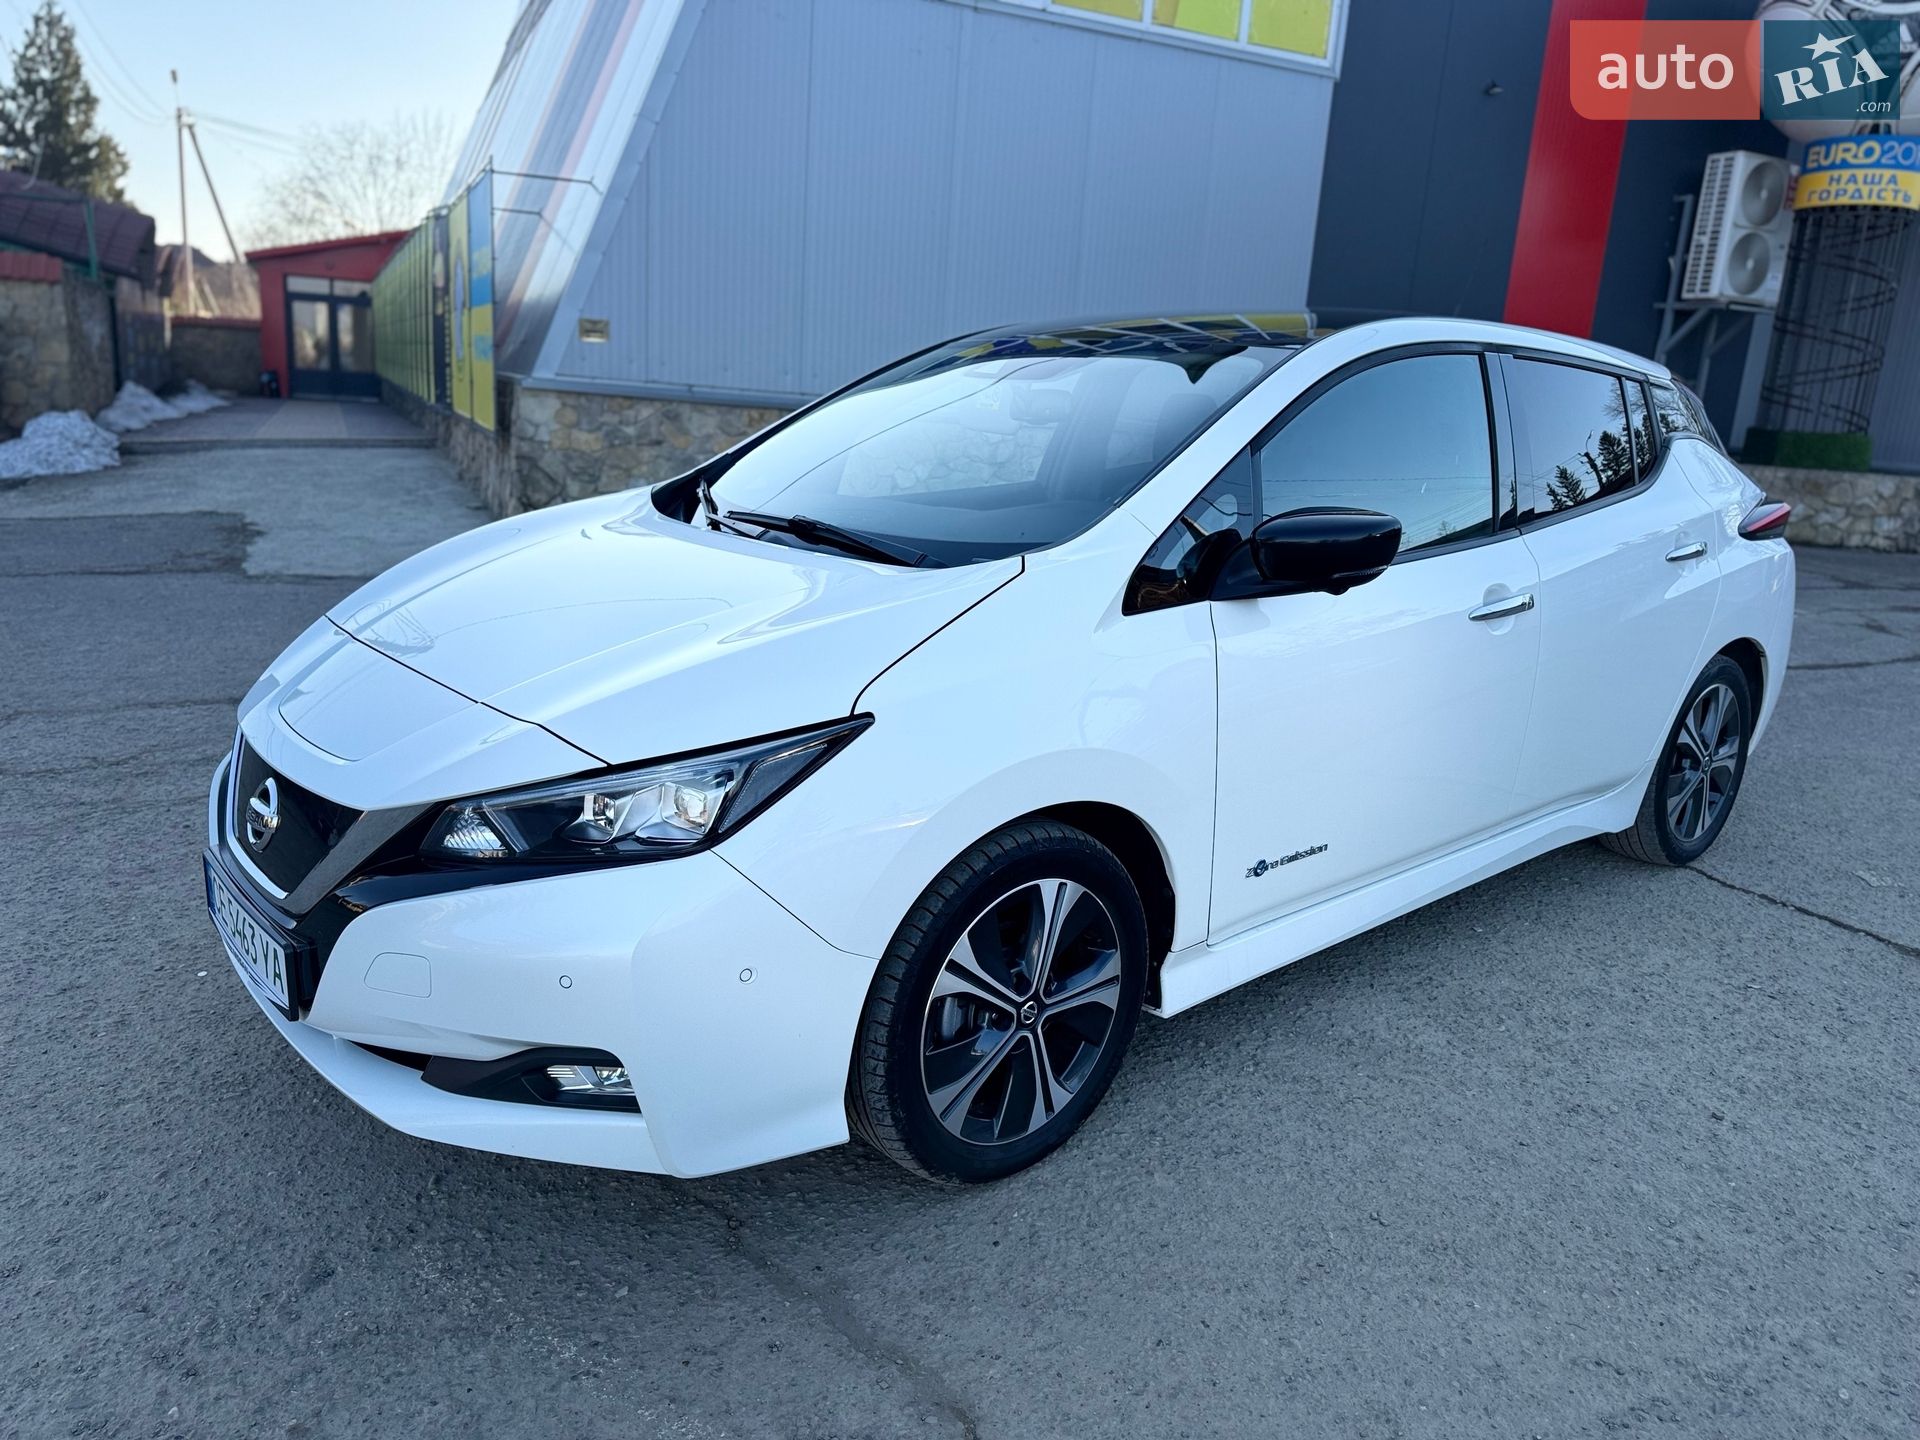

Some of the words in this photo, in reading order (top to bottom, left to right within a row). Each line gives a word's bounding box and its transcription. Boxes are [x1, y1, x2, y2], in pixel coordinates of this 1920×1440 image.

[1828, 173, 1898, 186] НАША
[1807, 188, 1912, 203] ГОРДІСТЬ
[227, 897, 258, 965] 5463
[259, 933, 285, 995] YA
